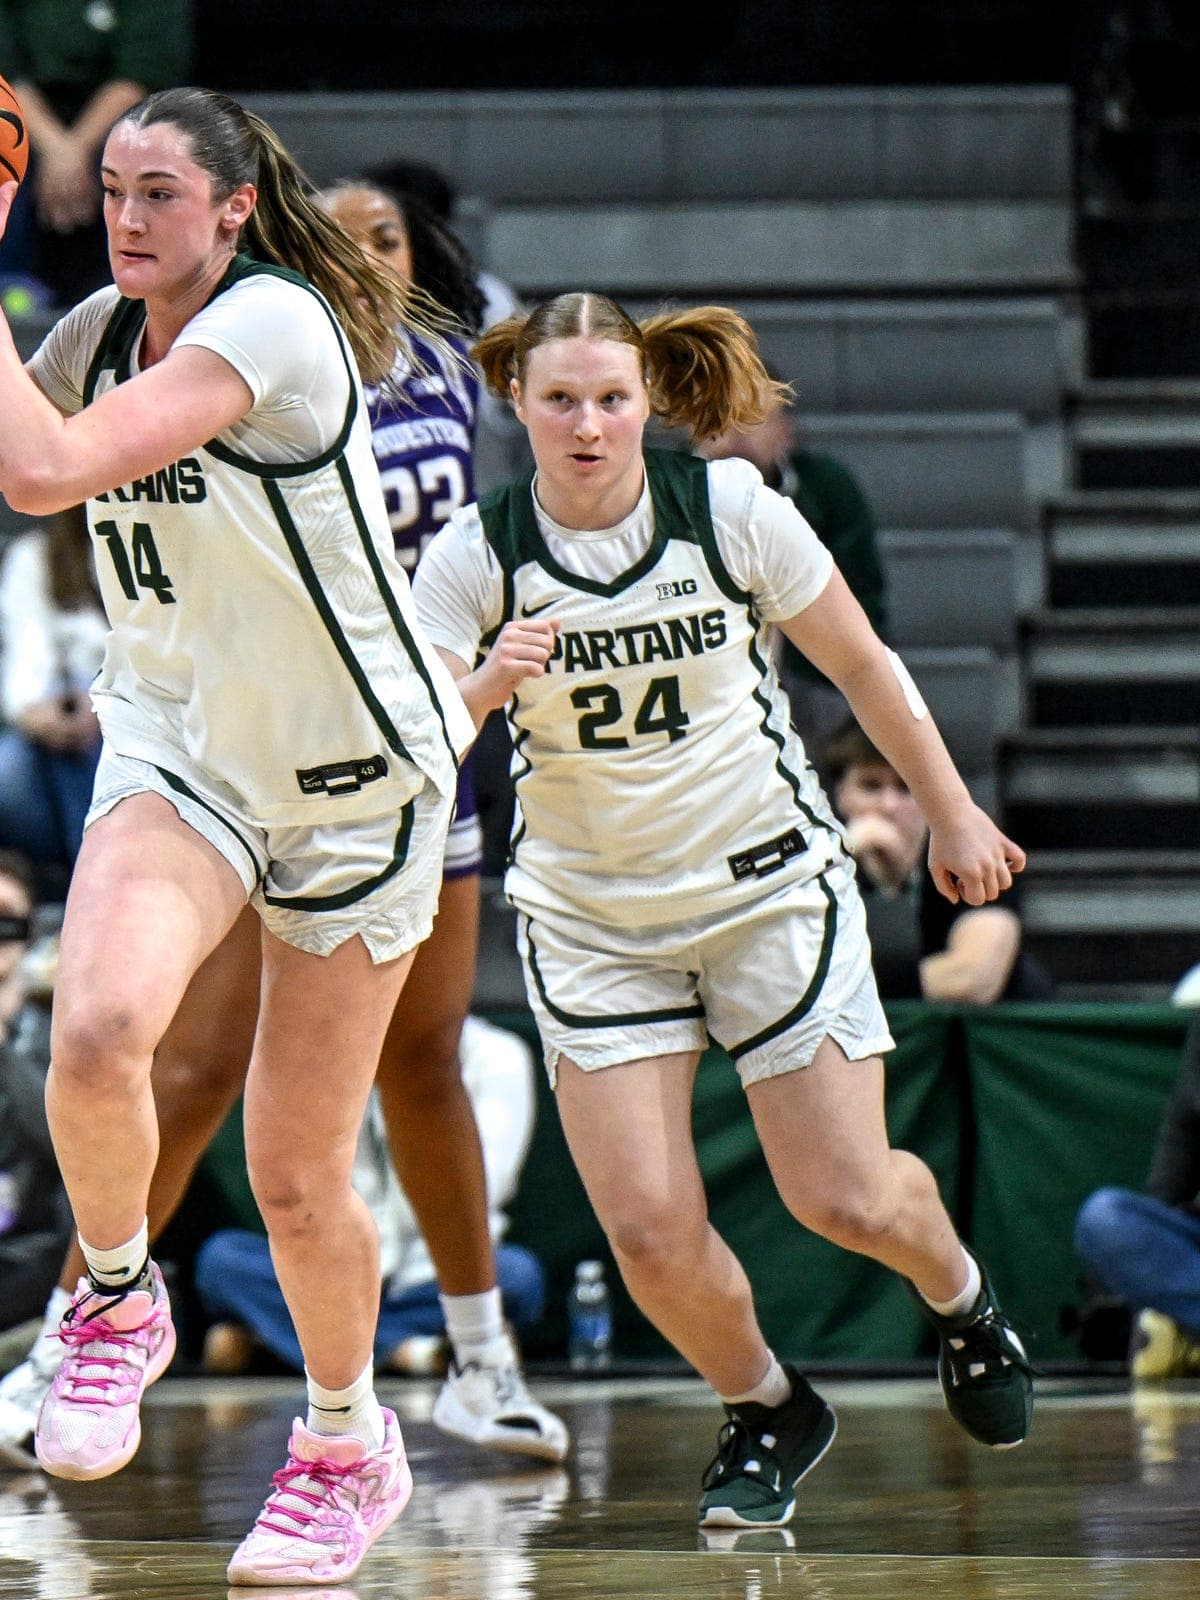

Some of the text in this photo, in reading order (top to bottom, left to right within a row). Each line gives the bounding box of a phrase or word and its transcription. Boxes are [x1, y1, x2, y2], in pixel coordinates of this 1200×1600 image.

[94, 520, 177, 605] 14
[544, 608, 728, 674] PARTANS
[569, 674, 691, 750] 24
[360, 765, 377, 777] 48
